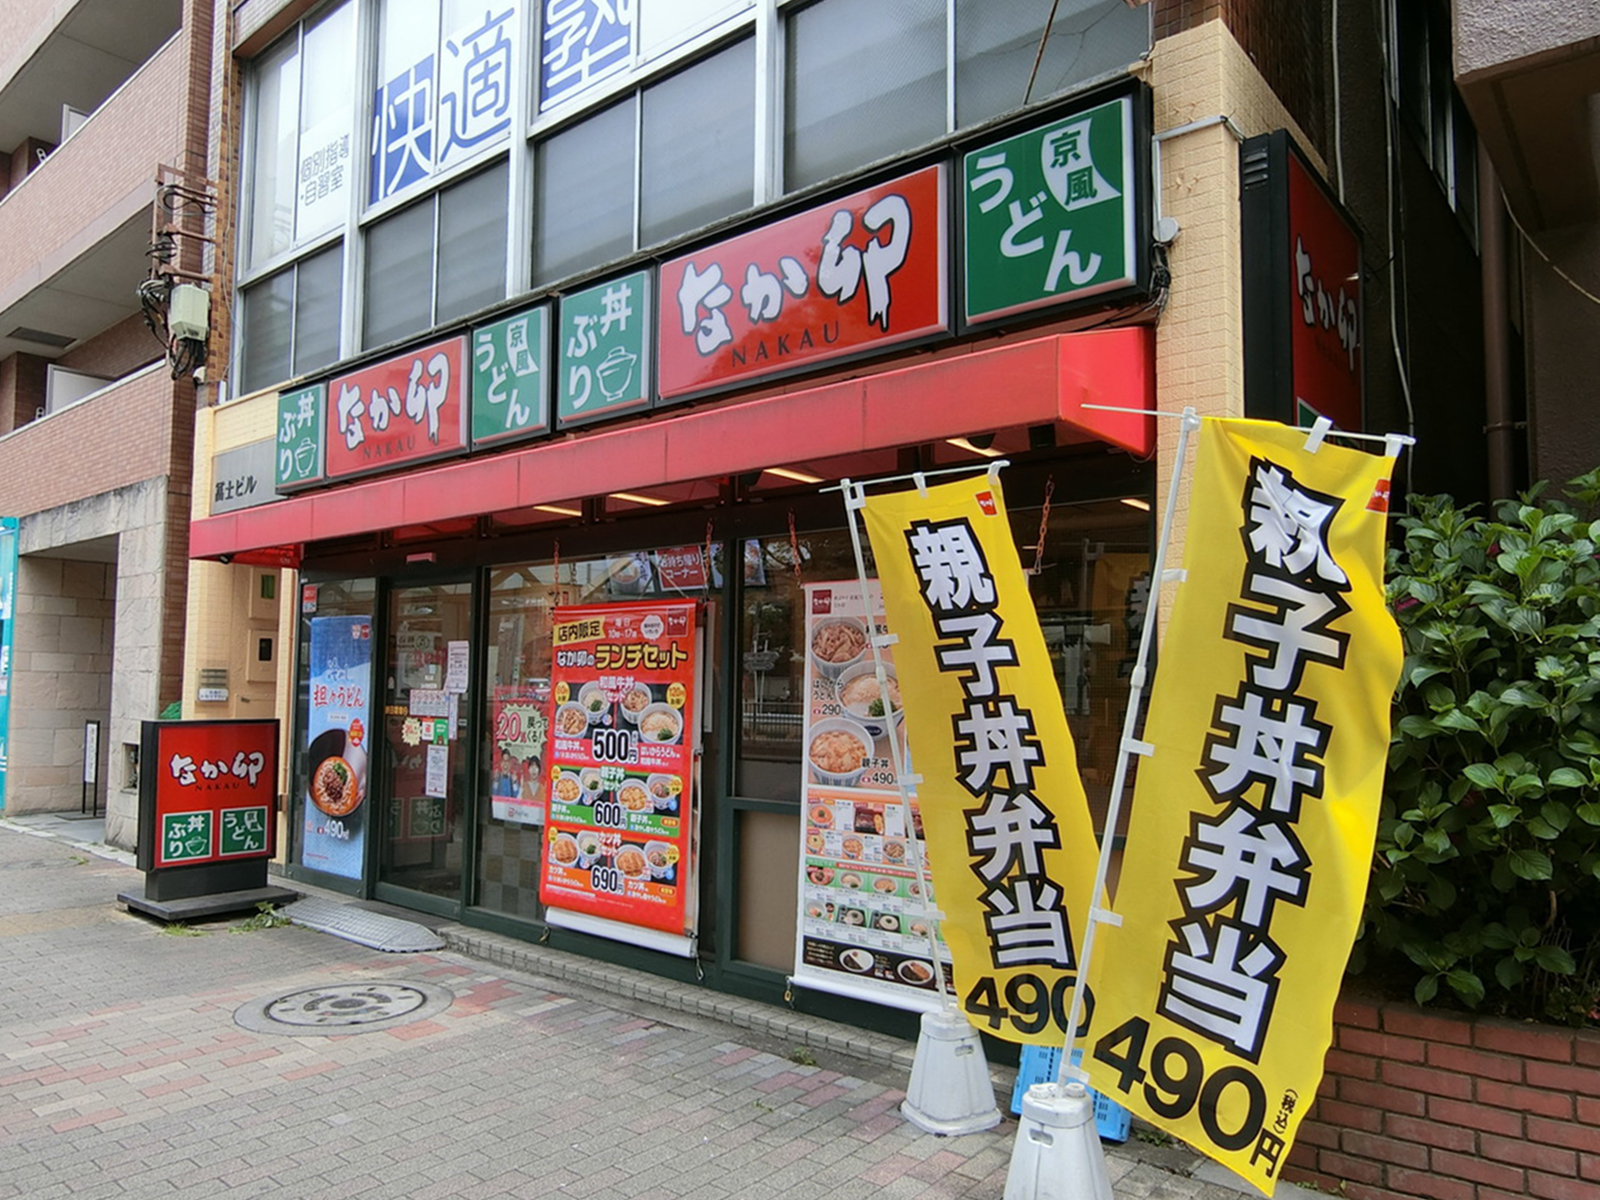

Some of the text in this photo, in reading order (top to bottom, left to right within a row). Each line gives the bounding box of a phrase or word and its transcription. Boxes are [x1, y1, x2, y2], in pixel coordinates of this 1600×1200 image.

[1051, 128, 1098, 207] 京風
[969, 152, 1102, 293] うどん
[678, 192, 912, 356] なか卯
[732, 321, 840, 367] NAKAU
[337, 352, 450, 450] なか卯
[476, 333, 530, 429] うどん
[363, 435, 416, 460] NAKAU
[666, 567, 699, 579] コーナー
[558, 620, 601, 642] 店内限定
[170, 750, 265, 787] なか卯
[905, 518, 1076, 970] 親子丼弁当
[1157, 457, 1352, 1064] 親子丼弁当
[195, 782, 241, 791] NAKAU
[224, 813, 259, 850] うどん
[964, 973, 1095, 1038] 490
